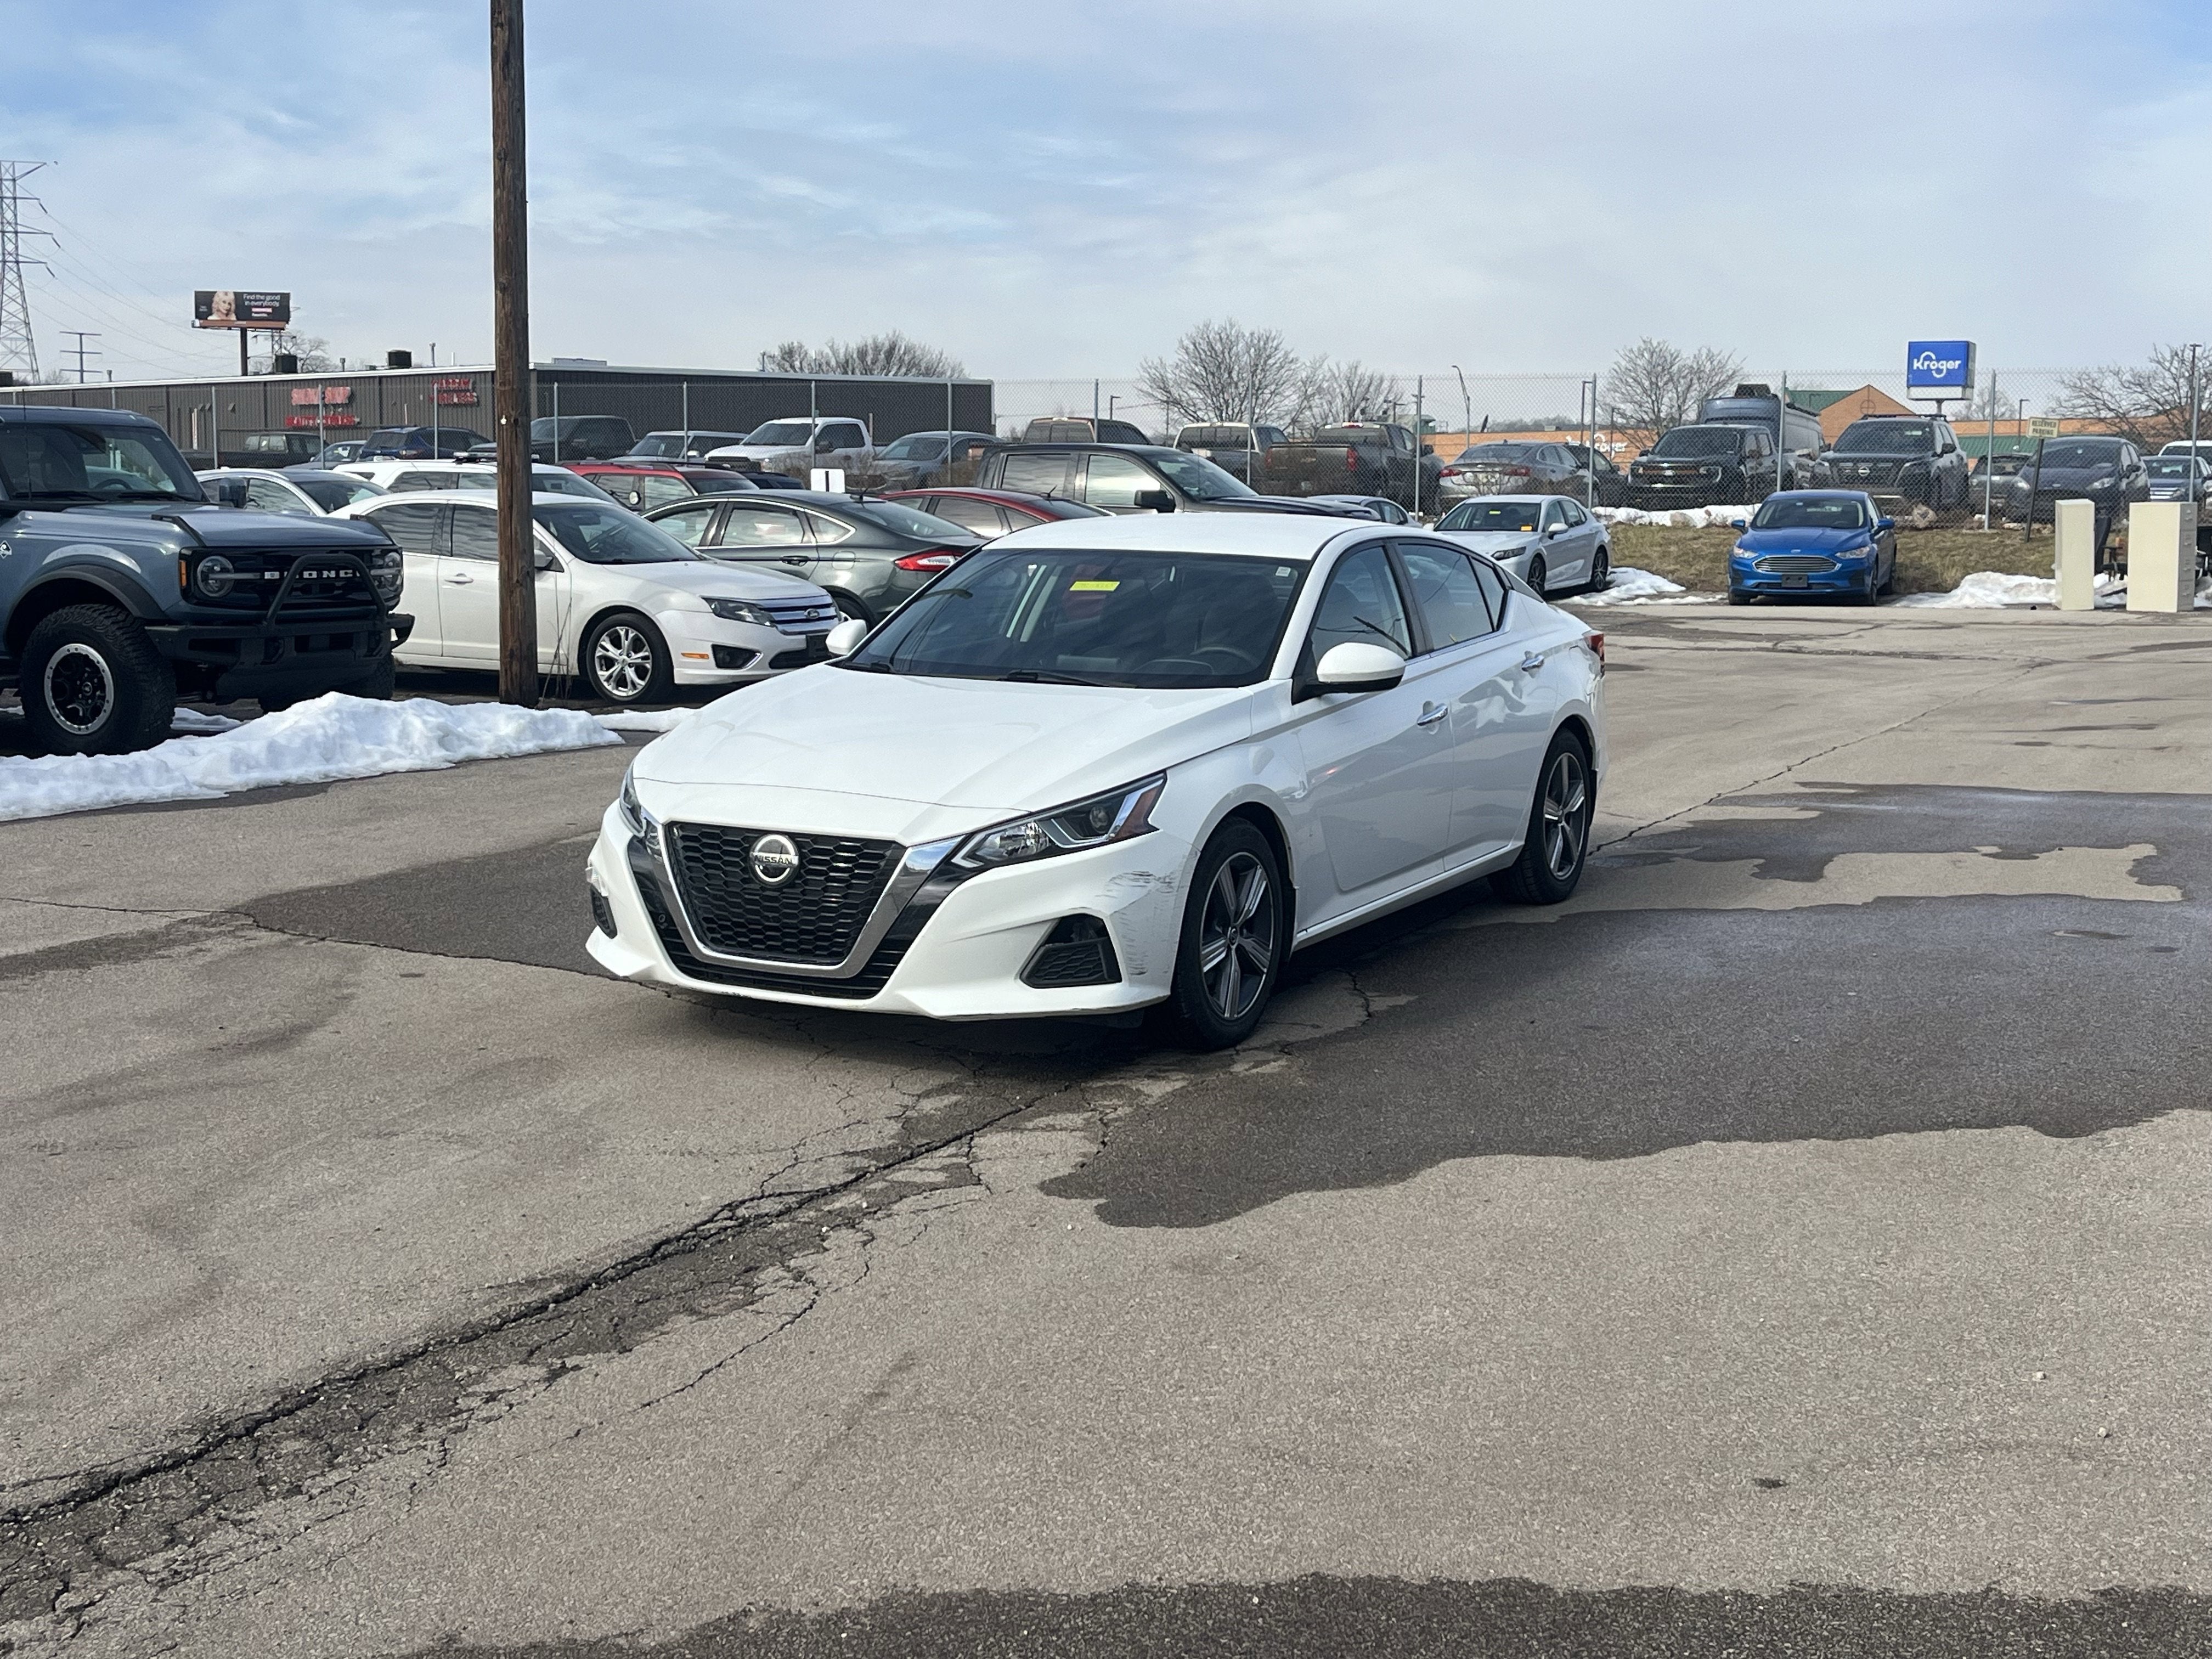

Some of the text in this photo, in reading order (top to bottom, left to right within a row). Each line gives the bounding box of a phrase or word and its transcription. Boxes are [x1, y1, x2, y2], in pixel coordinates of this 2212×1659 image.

[1913, 351, 1962, 379] Kroger
[264, 569, 360, 579] BONC
[755, 855, 795, 866] NISSAN
